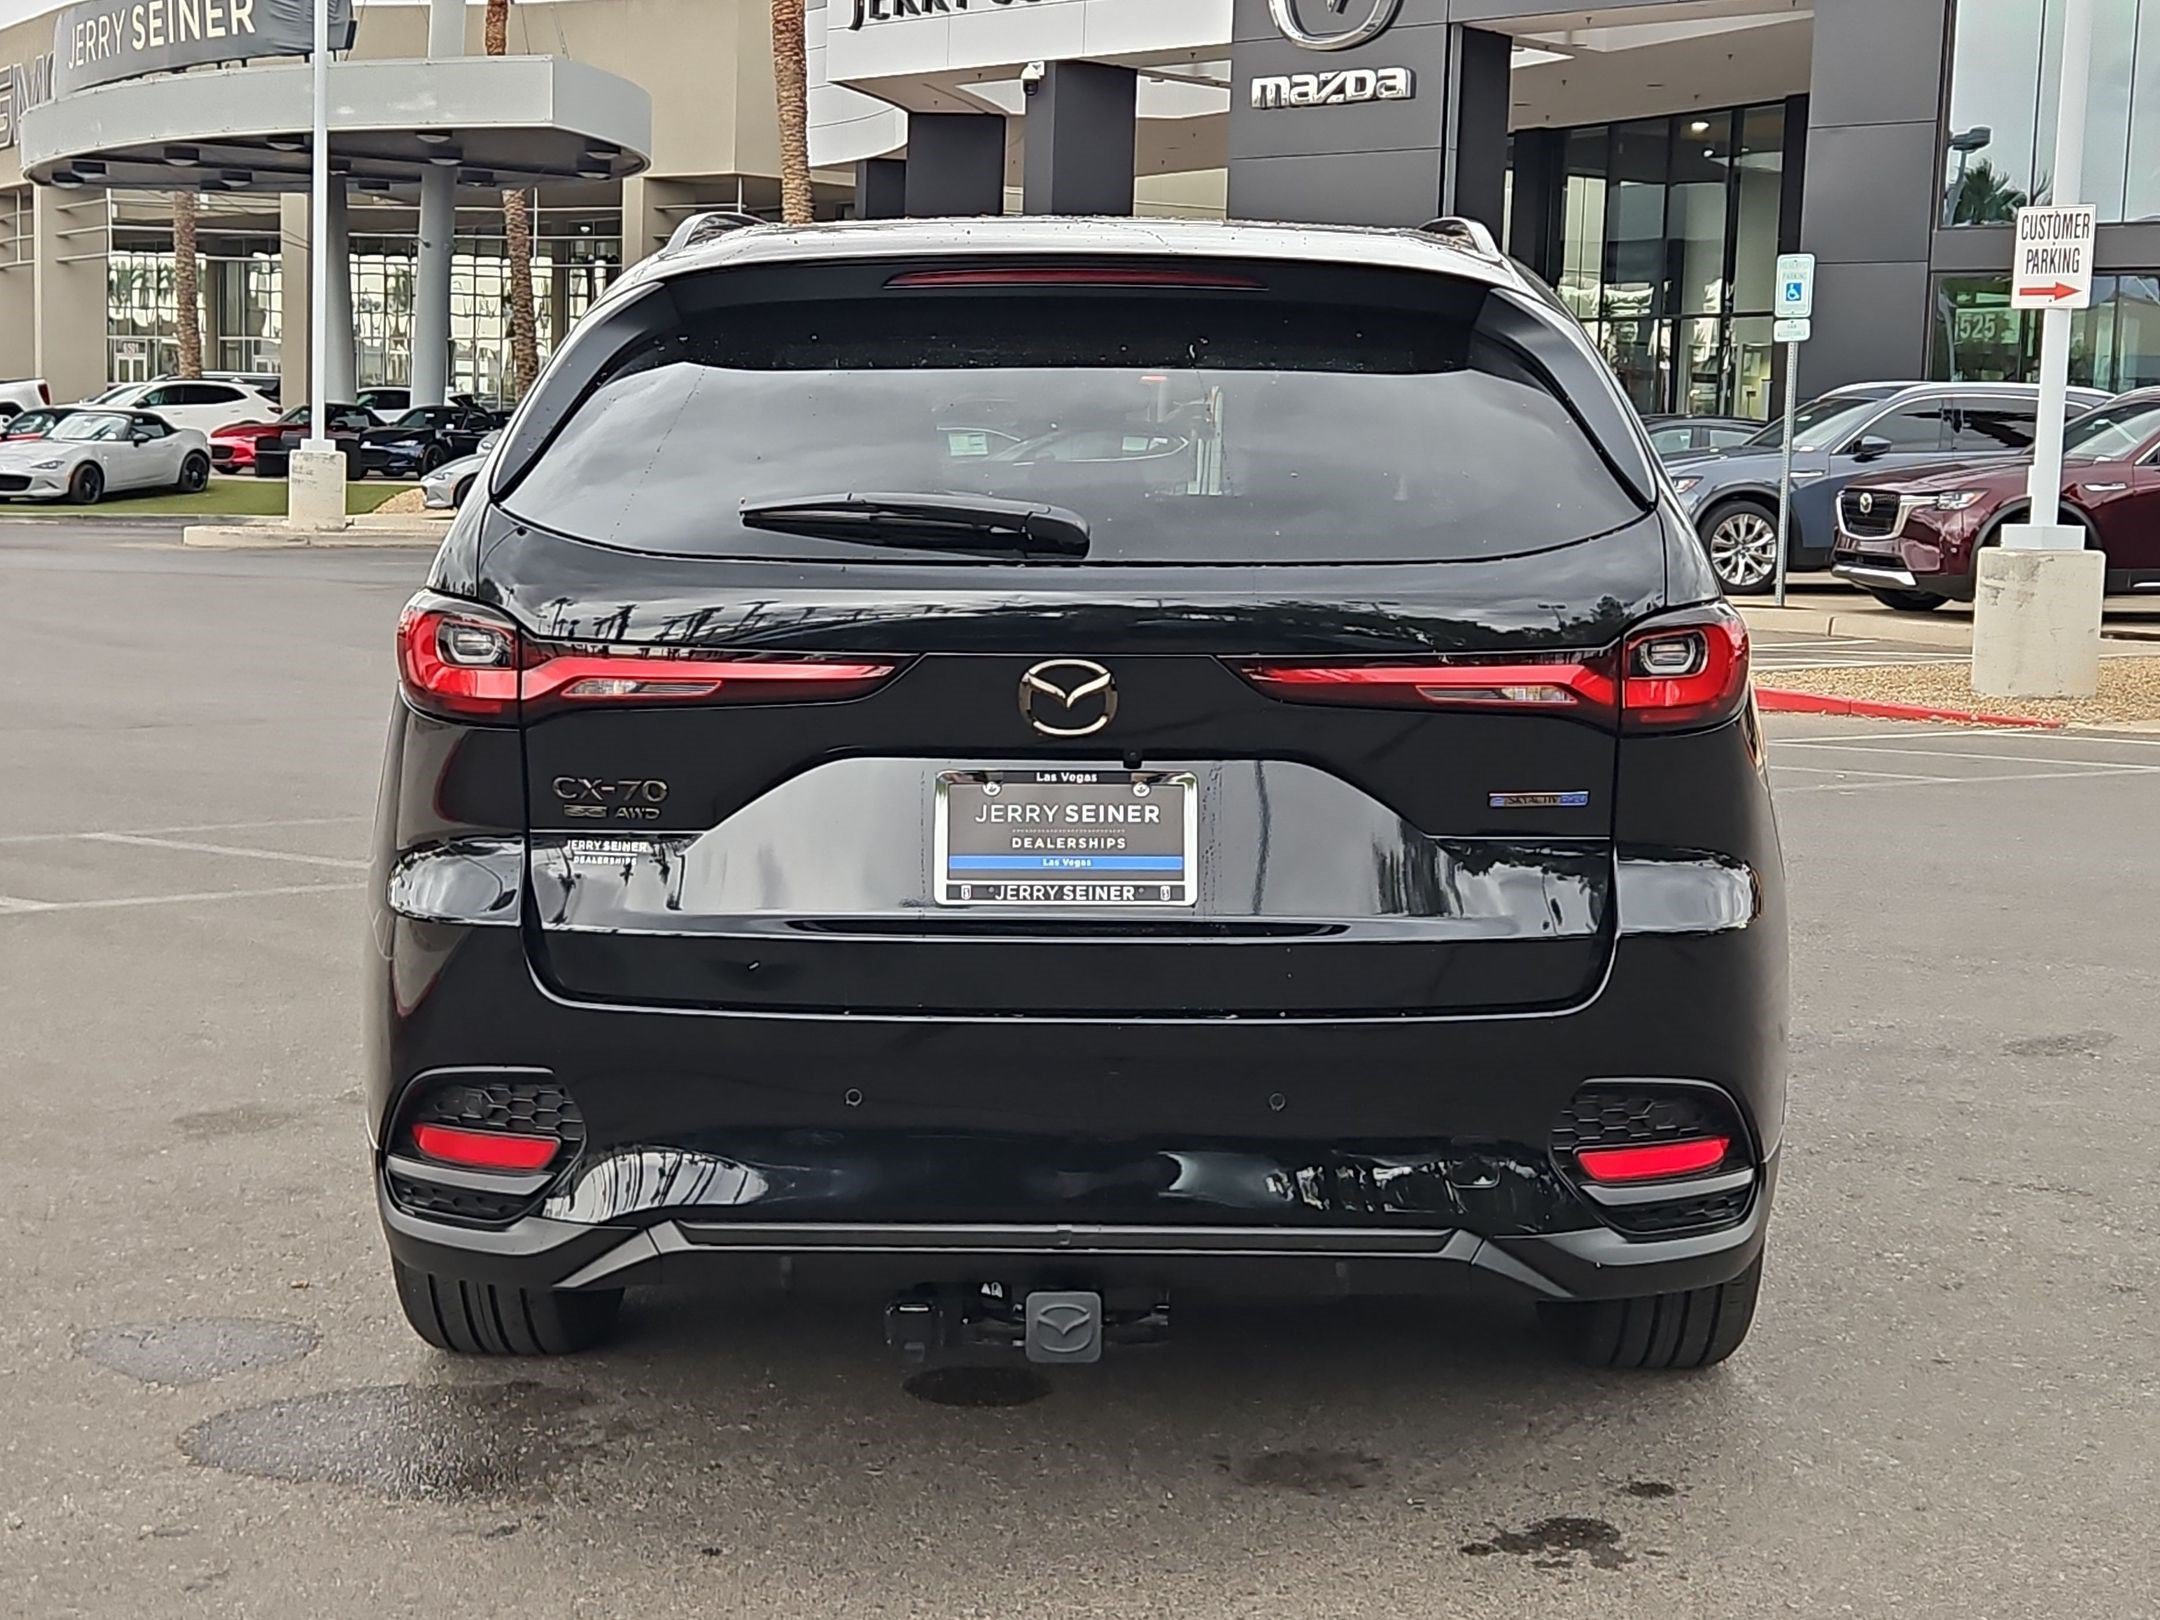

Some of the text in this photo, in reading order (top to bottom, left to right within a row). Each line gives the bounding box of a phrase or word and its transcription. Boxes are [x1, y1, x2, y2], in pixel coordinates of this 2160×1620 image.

[68, 0, 256, 69] JERRY SEINER
[2021, 213, 2091, 240] CUSTOMER
[2025, 247, 2081, 275] PARKING
[1036, 771, 1098, 785] Las Vegas
[552, 776, 668, 802] CX-70
[616, 806, 661, 819] AWD
[975, 804, 1161, 824] JERRY SEINER
[564, 840, 648, 853] JERRY SEINER
[1011, 837, 1127, 849] DEALERSHIPS
[1042, 858, 1093, 869] Las Vegas
[995, 885, 1136, 901] JERRY SEINER
